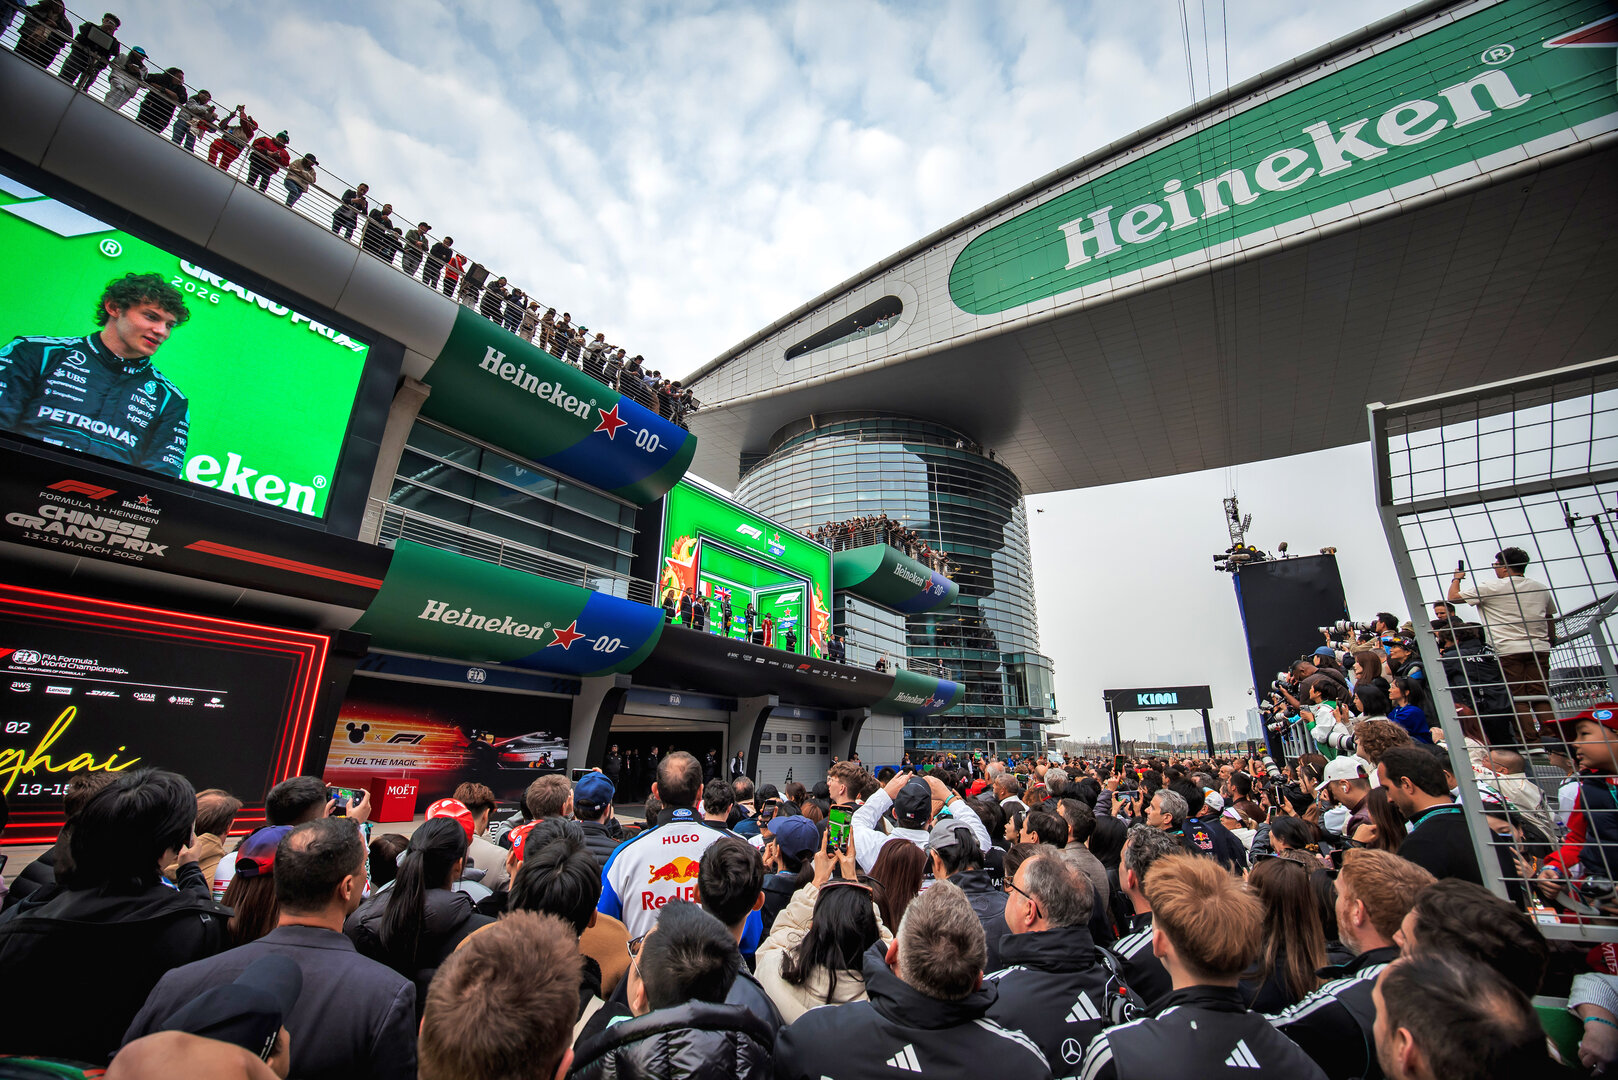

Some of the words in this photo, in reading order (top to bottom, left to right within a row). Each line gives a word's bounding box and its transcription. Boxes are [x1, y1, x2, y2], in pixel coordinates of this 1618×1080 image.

[1057, 68, 1532, 271] Heineken
[171, 276, 220, 304] 2026
[66, 371, 87, 384] UBS
[478, 346, 592, 420] Heineken
[130, 393, 157, 412] INEOS
[37, 405, 139, 448] PETRONAS
[126, 413, 149, 429] HPE
[183, 451, 317, 516] eken
[38, 491, 92, 510] FORMULA
[94, 504, 100, 512] 1
[109, 508, 160, 525] HEINEKEN
[121, 500, 160, 516] Heineken
[38, 504, 151, 540] CHINESE
[5, 512, 106, 543] GRAND
[107, 533, 169, 557] PRIX
[22, 531, 59, 544] 13-15
[61, 539, 111, 555] MARCH
[112, 551, 144, 562] 2026
[893, 563, 924, 587] Heineken
[418, 600, 546, 640] Heineken
[14, 651, 38, 663] FIA
[40, 660, 67, 668] World
[42, 653, 57, 661] FIA
[58, 655, 93, 665] Formula
[468, 670, 485, 682] FIA
[11, 681, 32, 689] aws
[1137, 692, 1178, 705] KIMI
[5, 721, 31, 734] 02
[344, 757, 368, 765] FUEL
[370, 758, 388, 766] THE
[662, 834, 700, 845] HUGO
